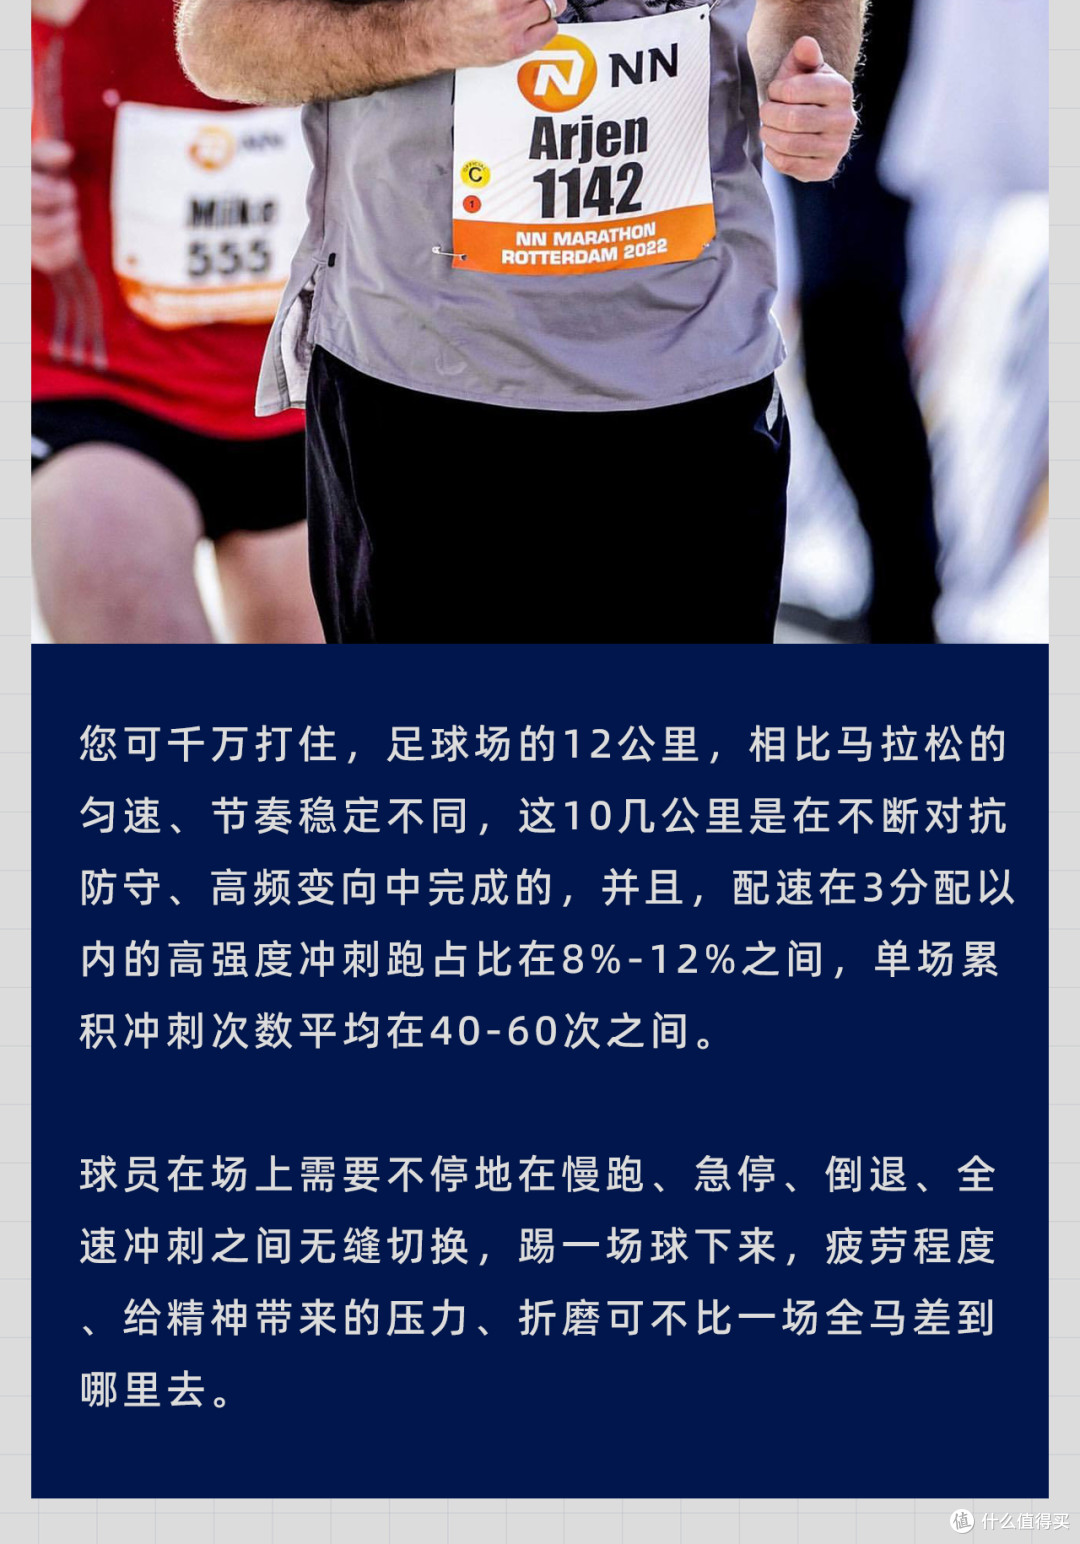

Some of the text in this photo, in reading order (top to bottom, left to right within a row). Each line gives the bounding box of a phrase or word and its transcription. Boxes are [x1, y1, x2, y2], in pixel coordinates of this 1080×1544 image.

[608, 42, 678, 88] NN
[529, 114, 648, 164] Arjen
[468, 166, 483, 183] C
[533, 161, 644, 219] 1142
[188, 197, 280, 226] Mike
[515, 221, 657, 247] NN MARATHON
[188, 239, 272, 278] 555
[501, 238, 668, 266] ROTTERDAM 2022
